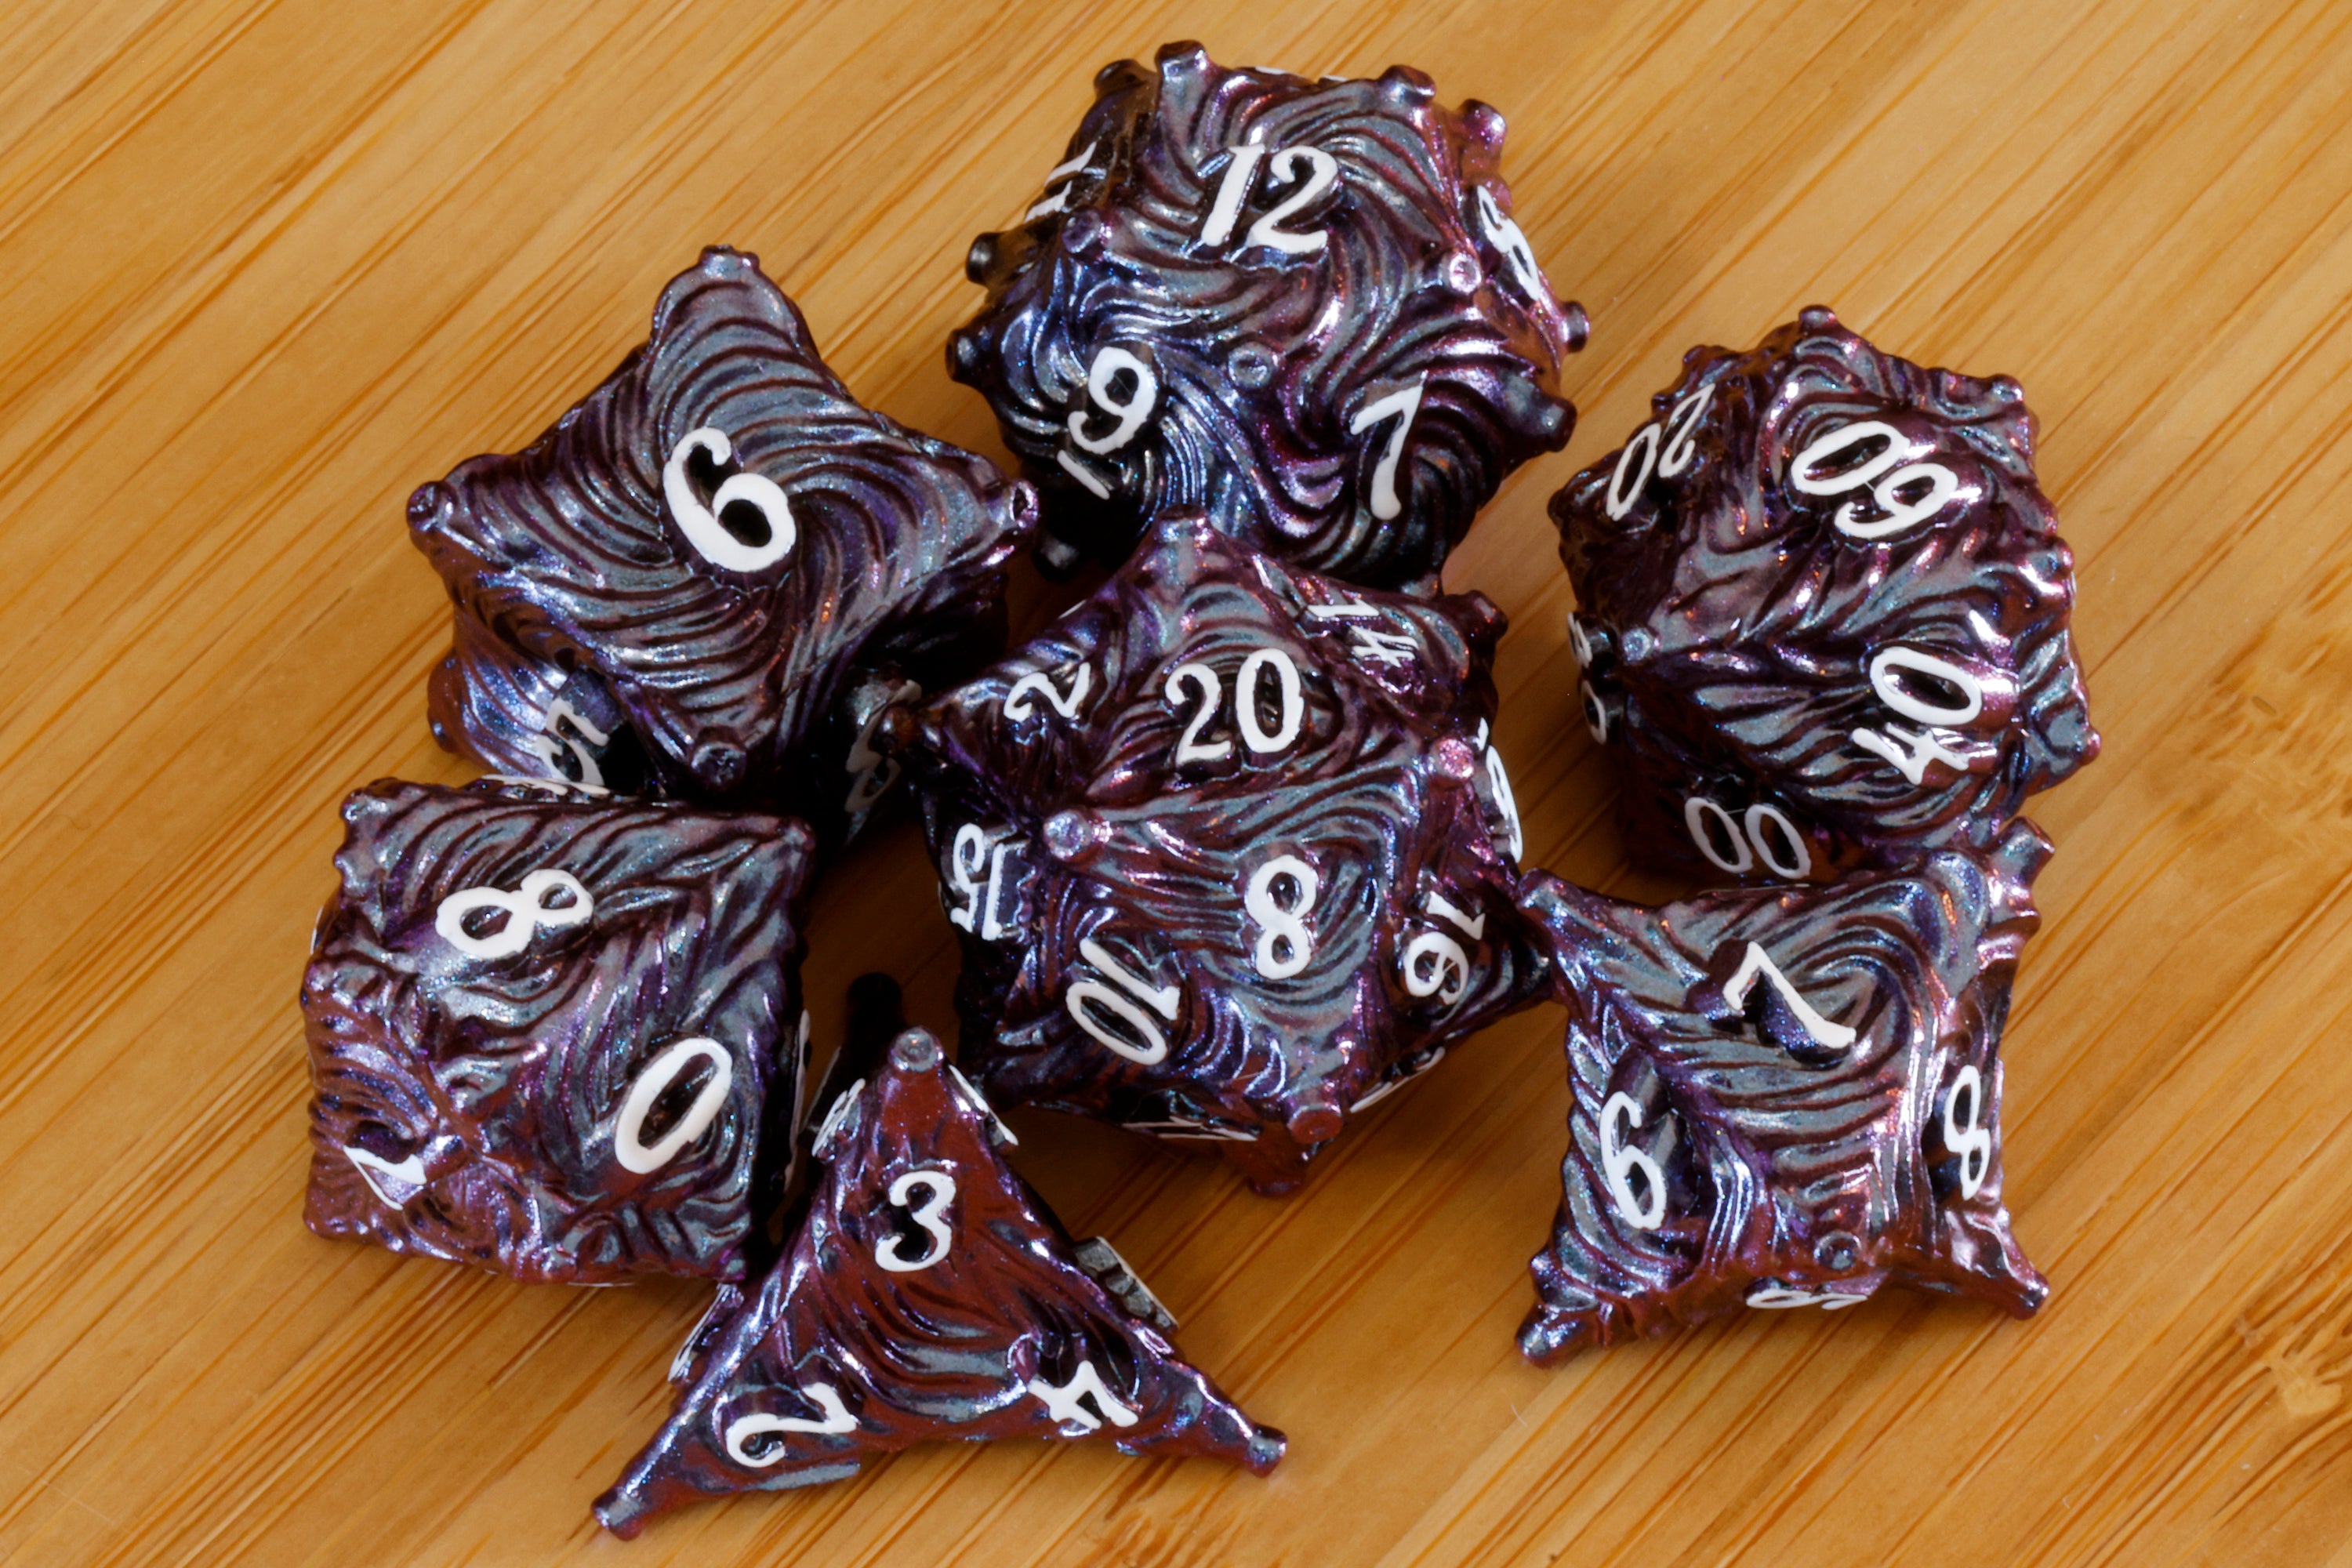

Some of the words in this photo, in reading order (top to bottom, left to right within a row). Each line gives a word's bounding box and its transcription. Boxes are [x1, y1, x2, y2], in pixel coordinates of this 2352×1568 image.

[1200, 144, 1339, 255] 12
[1067, 346, 1156, 456] 9
[1349, 384, 1425, 521] 7
[663, 426, 797, 573] 6
[1308, 597, 1419, 669] 14
[1003, 662, 1091, 722] 2
[1163, 647, 1305, 764] 20
[1851, 646, 1983, 786] 40
[949, 822, 1004, 942] 15
[1684, 797, 1813, 880] 00
[435, 868, 594, 959] 8
[1244, 854, 1319, 980] 8
[1065, 937, 1181, 1066] 10
[614, 1037, 734, 1174] 0
[1599, 1091, 1667, 1230] 6
[1944, 1064, 1992, 1200] 8
[875, 1170, 957, 1272] 3
[725, 1381, 858, 1468] 2
[1026, 1359, 1140, 1430] 4
